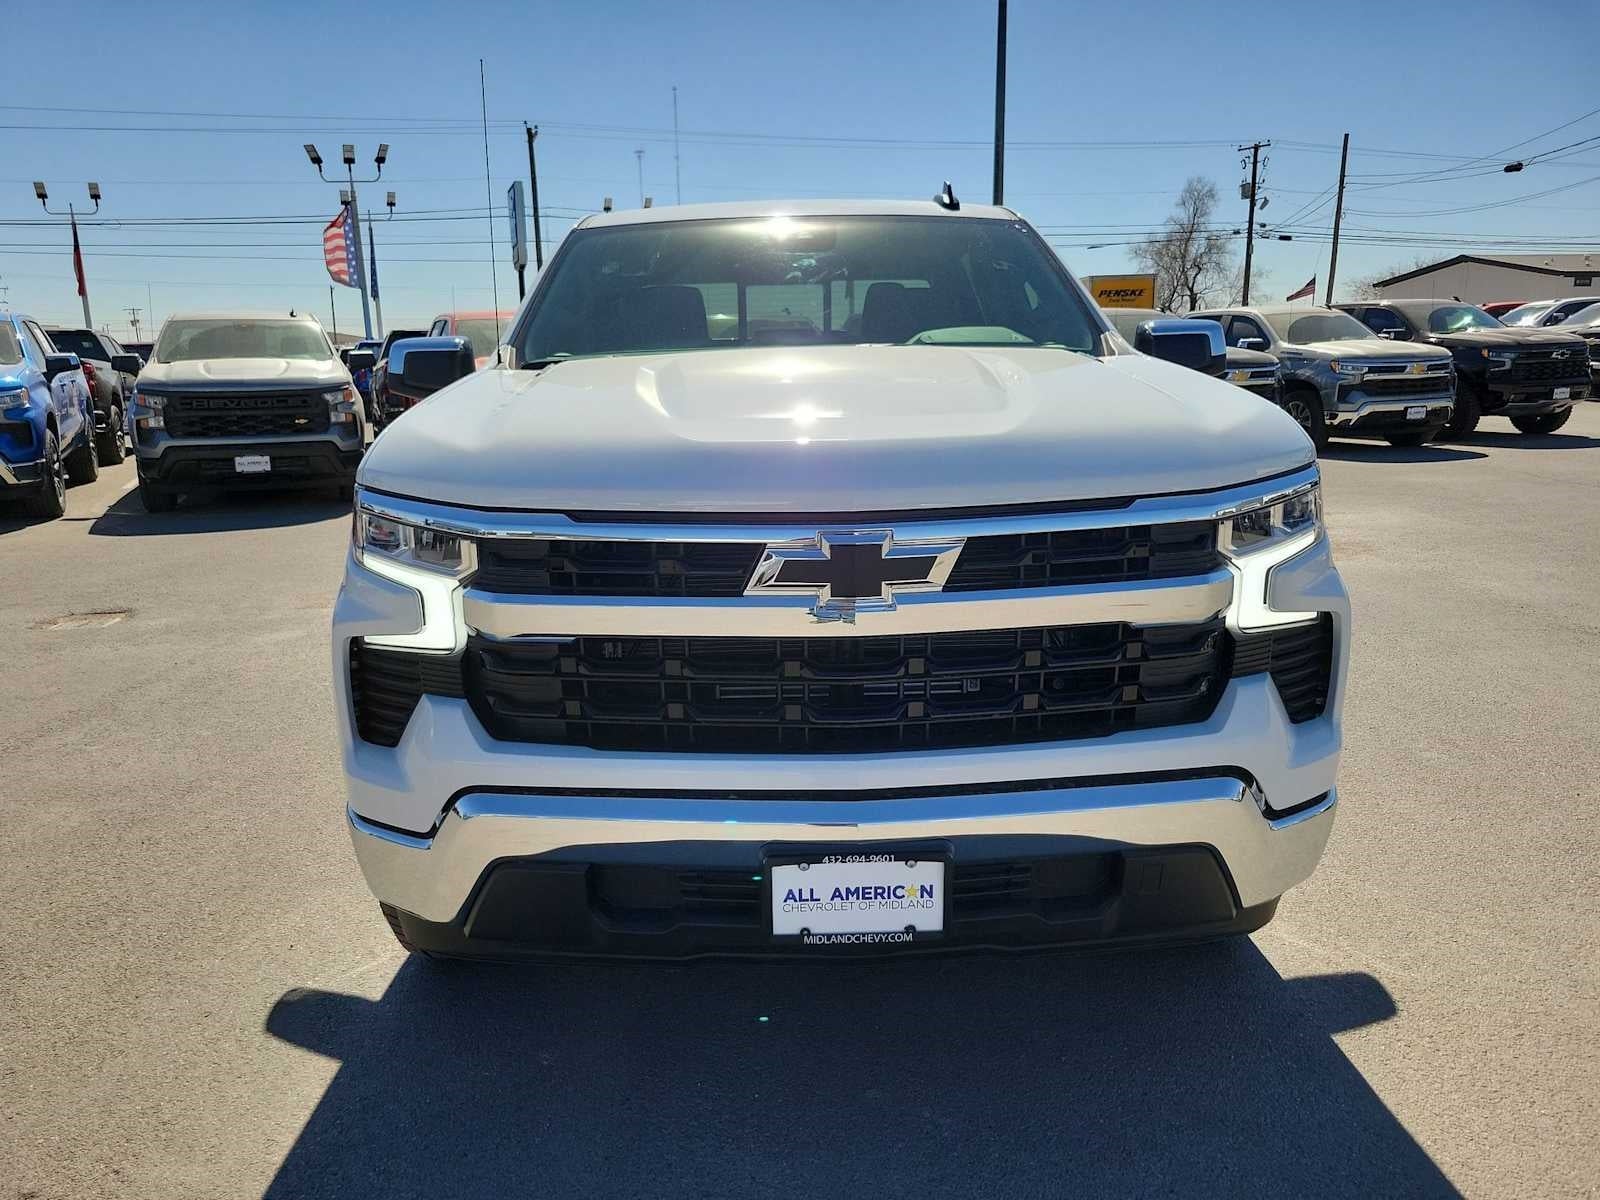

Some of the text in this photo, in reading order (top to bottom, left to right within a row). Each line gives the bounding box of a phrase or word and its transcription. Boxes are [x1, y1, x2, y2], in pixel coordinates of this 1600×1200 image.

[1098, 288, 1146, 298] PENSKE
[822, 854, 895, 864] 432-694-9601
[783, 888, 820, 902] ALL
[782, 899, 934, 913] CHEVROLET OF MIDLAND
[803, 932, 913, 945] MIDLANDCHEVY.COM
